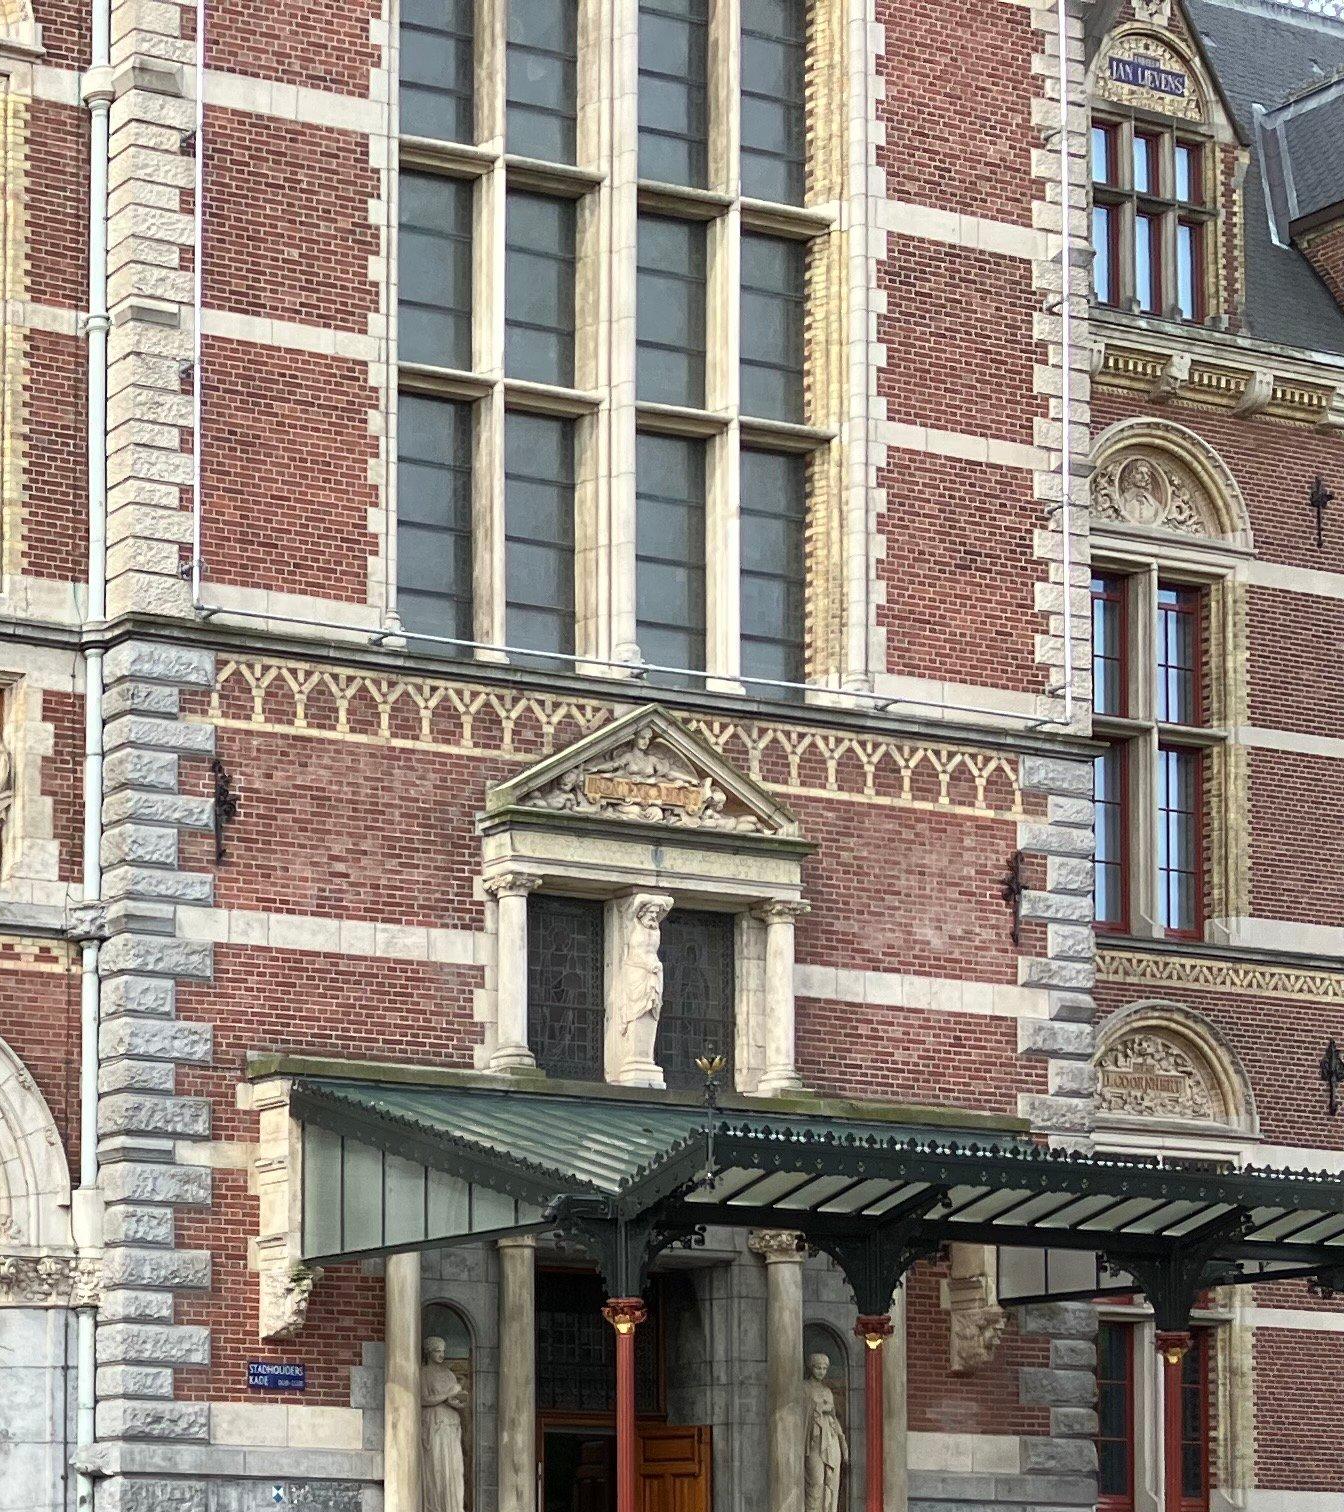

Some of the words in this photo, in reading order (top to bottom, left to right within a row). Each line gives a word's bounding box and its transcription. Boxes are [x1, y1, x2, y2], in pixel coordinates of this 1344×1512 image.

[1112, 60, 1133, 81] JAN
[1138, 67, 1184, 95] LIEVENS
[249, 1364, 304, 1377] STADHOUDERS
[249, 1376, 269, 1386] KADE
